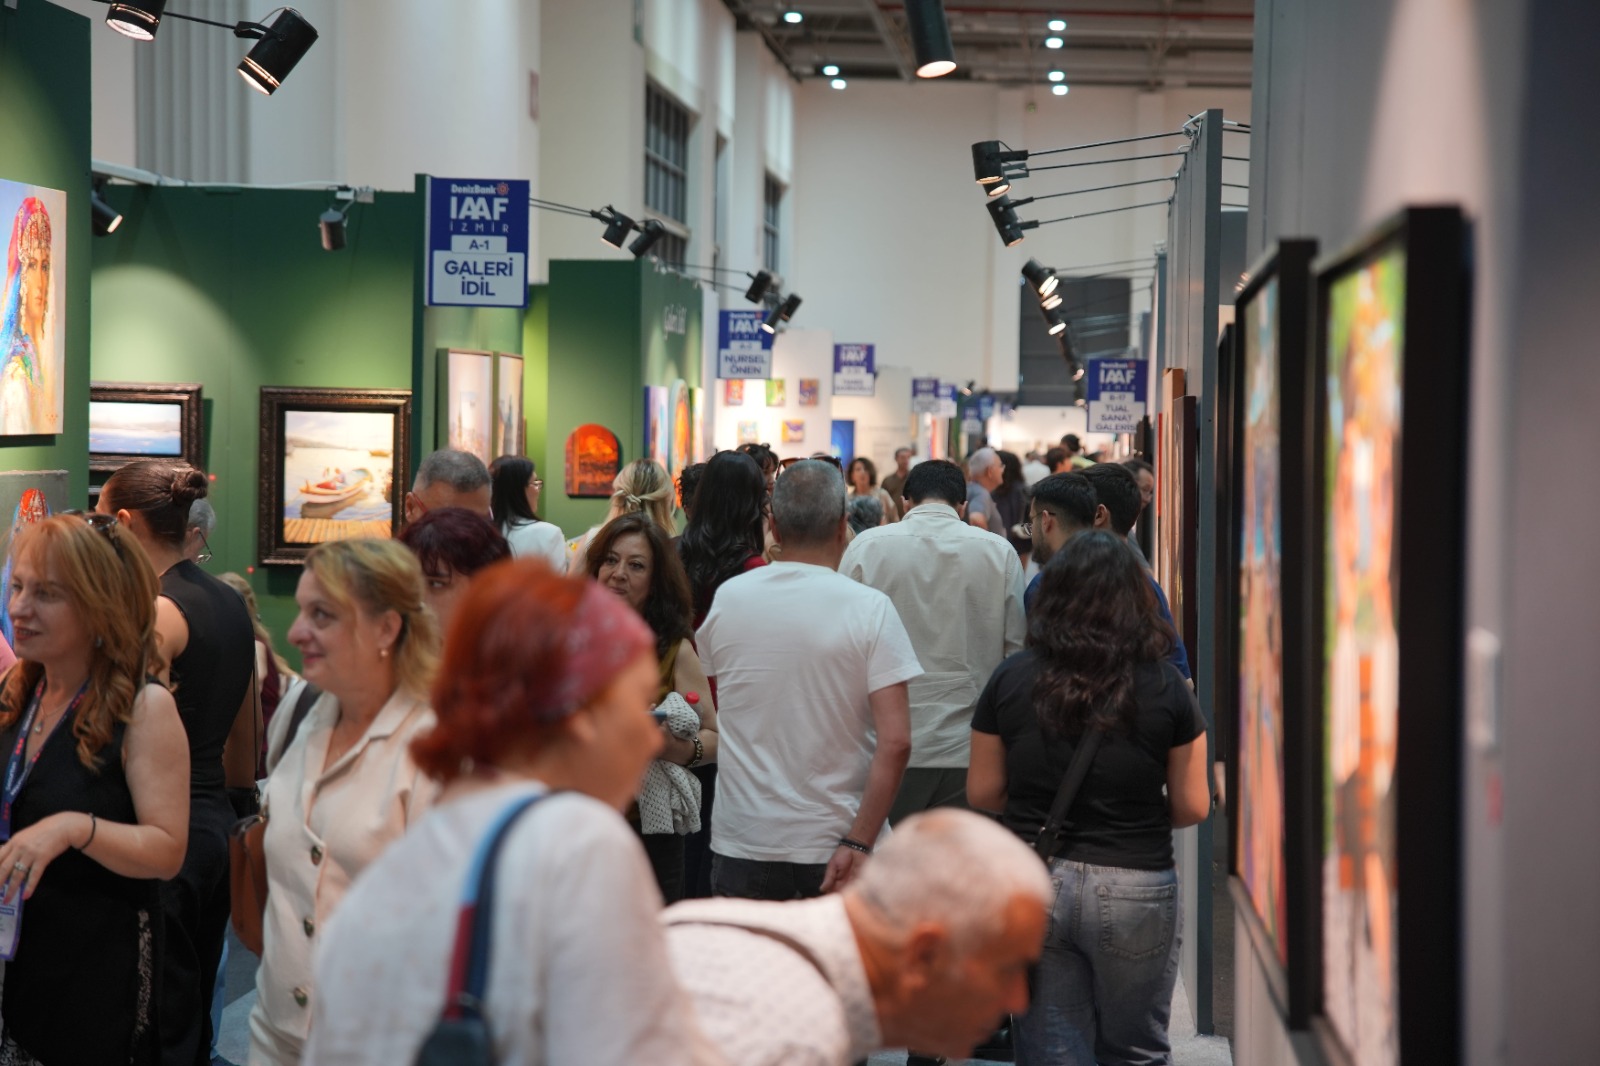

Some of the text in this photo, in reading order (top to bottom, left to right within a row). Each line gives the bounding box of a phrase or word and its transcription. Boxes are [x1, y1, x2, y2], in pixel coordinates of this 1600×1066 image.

[450, 184, 497, 195] DenizBank
[450, 196, 509, 221] IAAF
[469, 239, 489, 250] A-1
[444, 257, 513, 276] GALERİ
[461, 276, 496, 296] İDİL
[729, 319, 762, 334] IAAF
[725, 354, 765, 364] NURSEL
[730, 365, 761, 375] ÖNEN
[1099, 369, 1136, 384] IAAF
